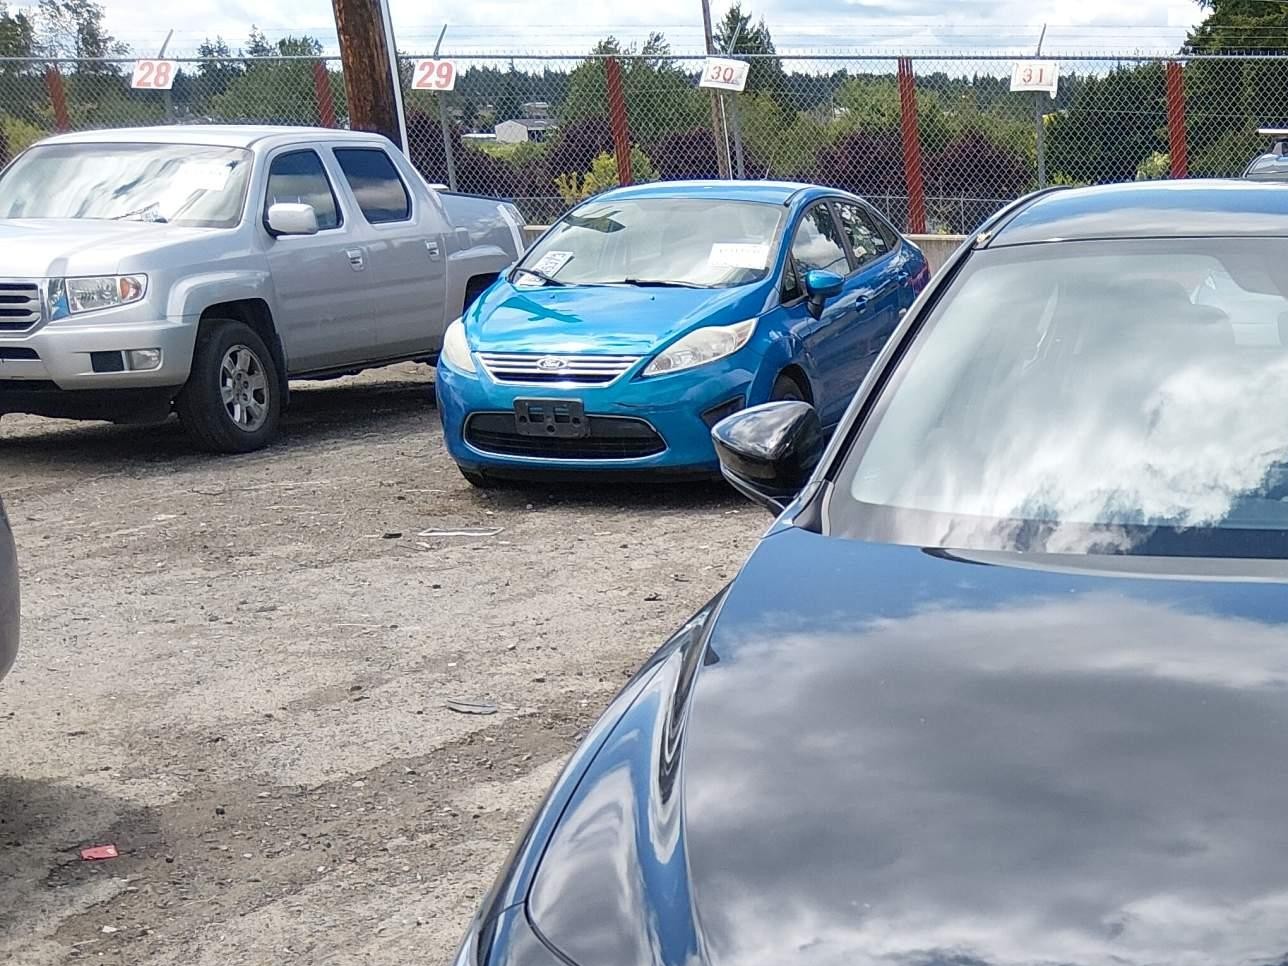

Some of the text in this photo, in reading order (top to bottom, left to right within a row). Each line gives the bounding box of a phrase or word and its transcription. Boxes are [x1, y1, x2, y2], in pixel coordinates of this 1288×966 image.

[136, 61, 172, 88] 28
[415, 61, 454, 89] 29
[710, 65, 735, 82] 30
[1022, 67, 1044, 84] 31
